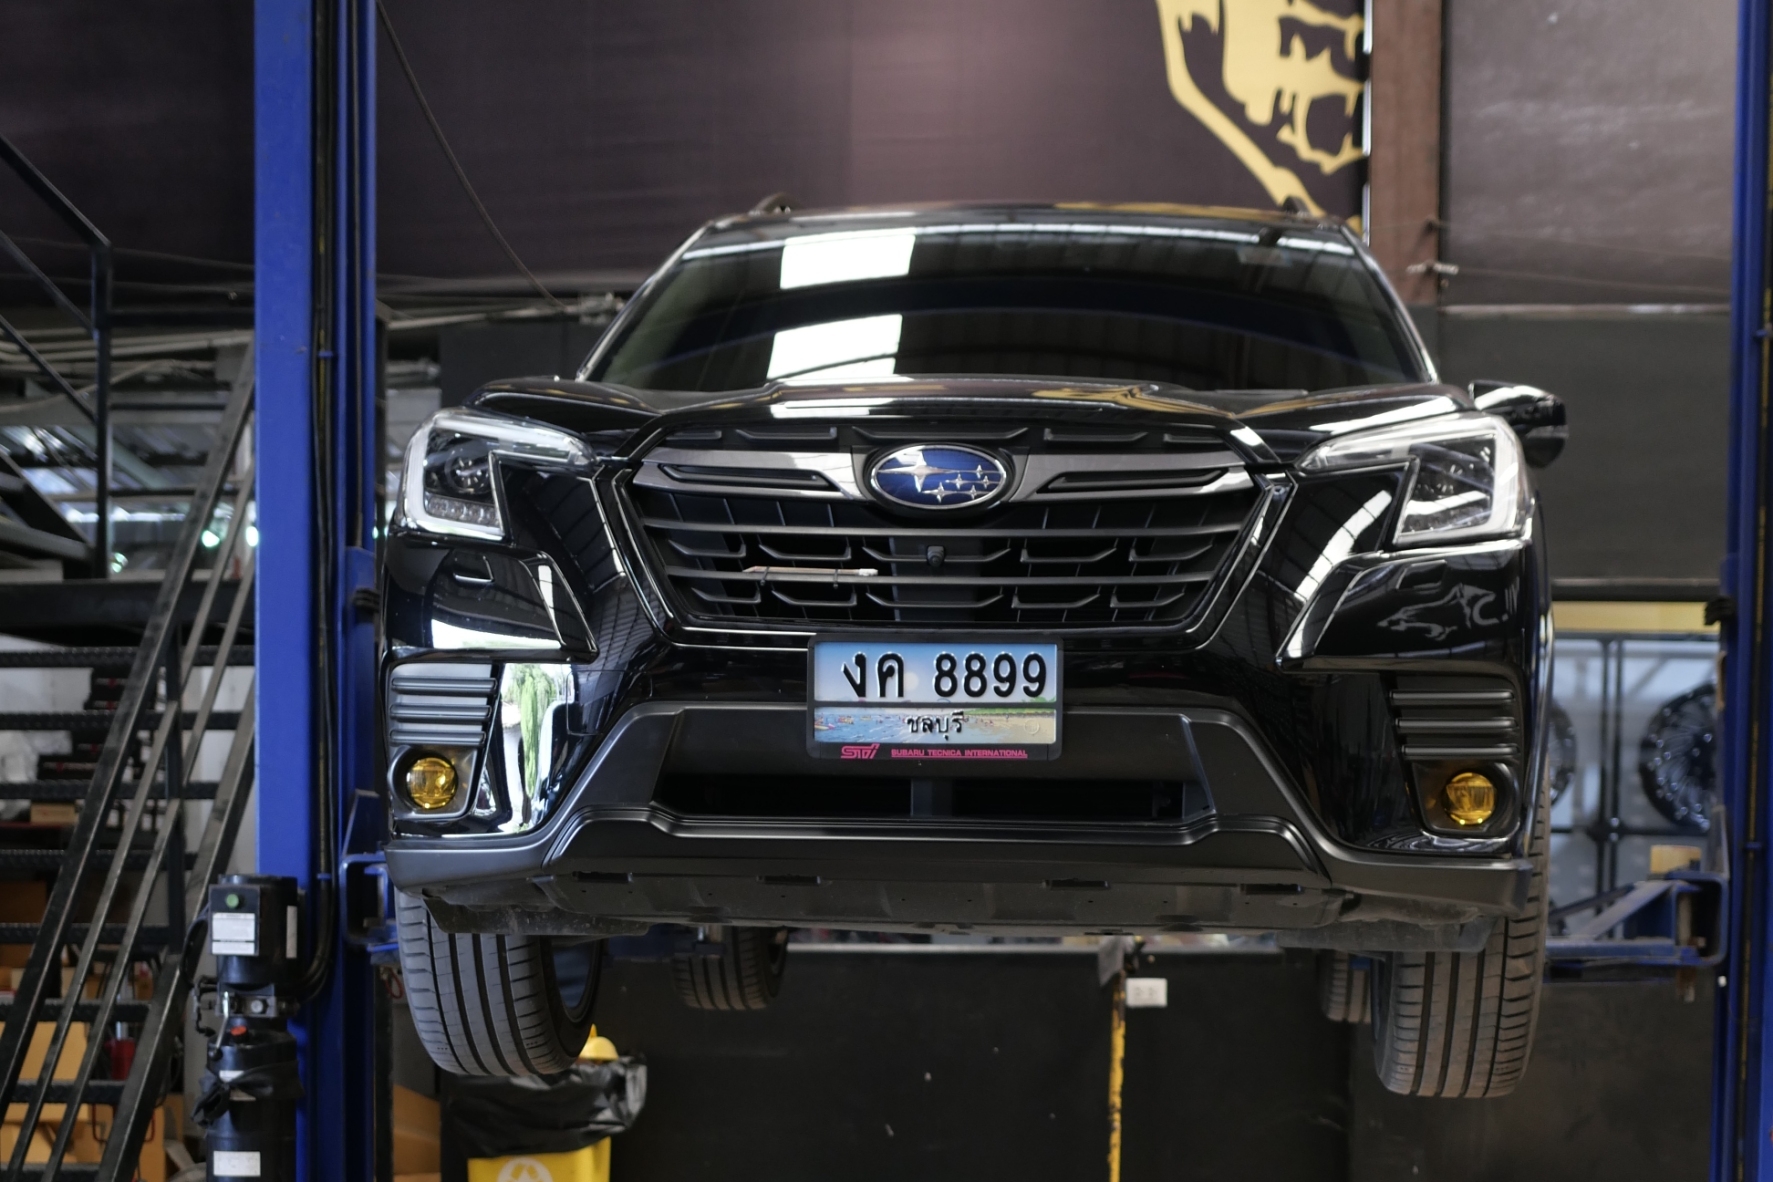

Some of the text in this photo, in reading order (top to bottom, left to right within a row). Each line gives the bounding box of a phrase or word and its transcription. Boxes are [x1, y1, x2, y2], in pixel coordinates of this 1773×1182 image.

[842, 651, 1047, 698] งค 8899
[907, 711, 965, 740] ชลบุรี
[891, 749, 1028, 758] SUBARU TECNICA INTERNATIONAL
